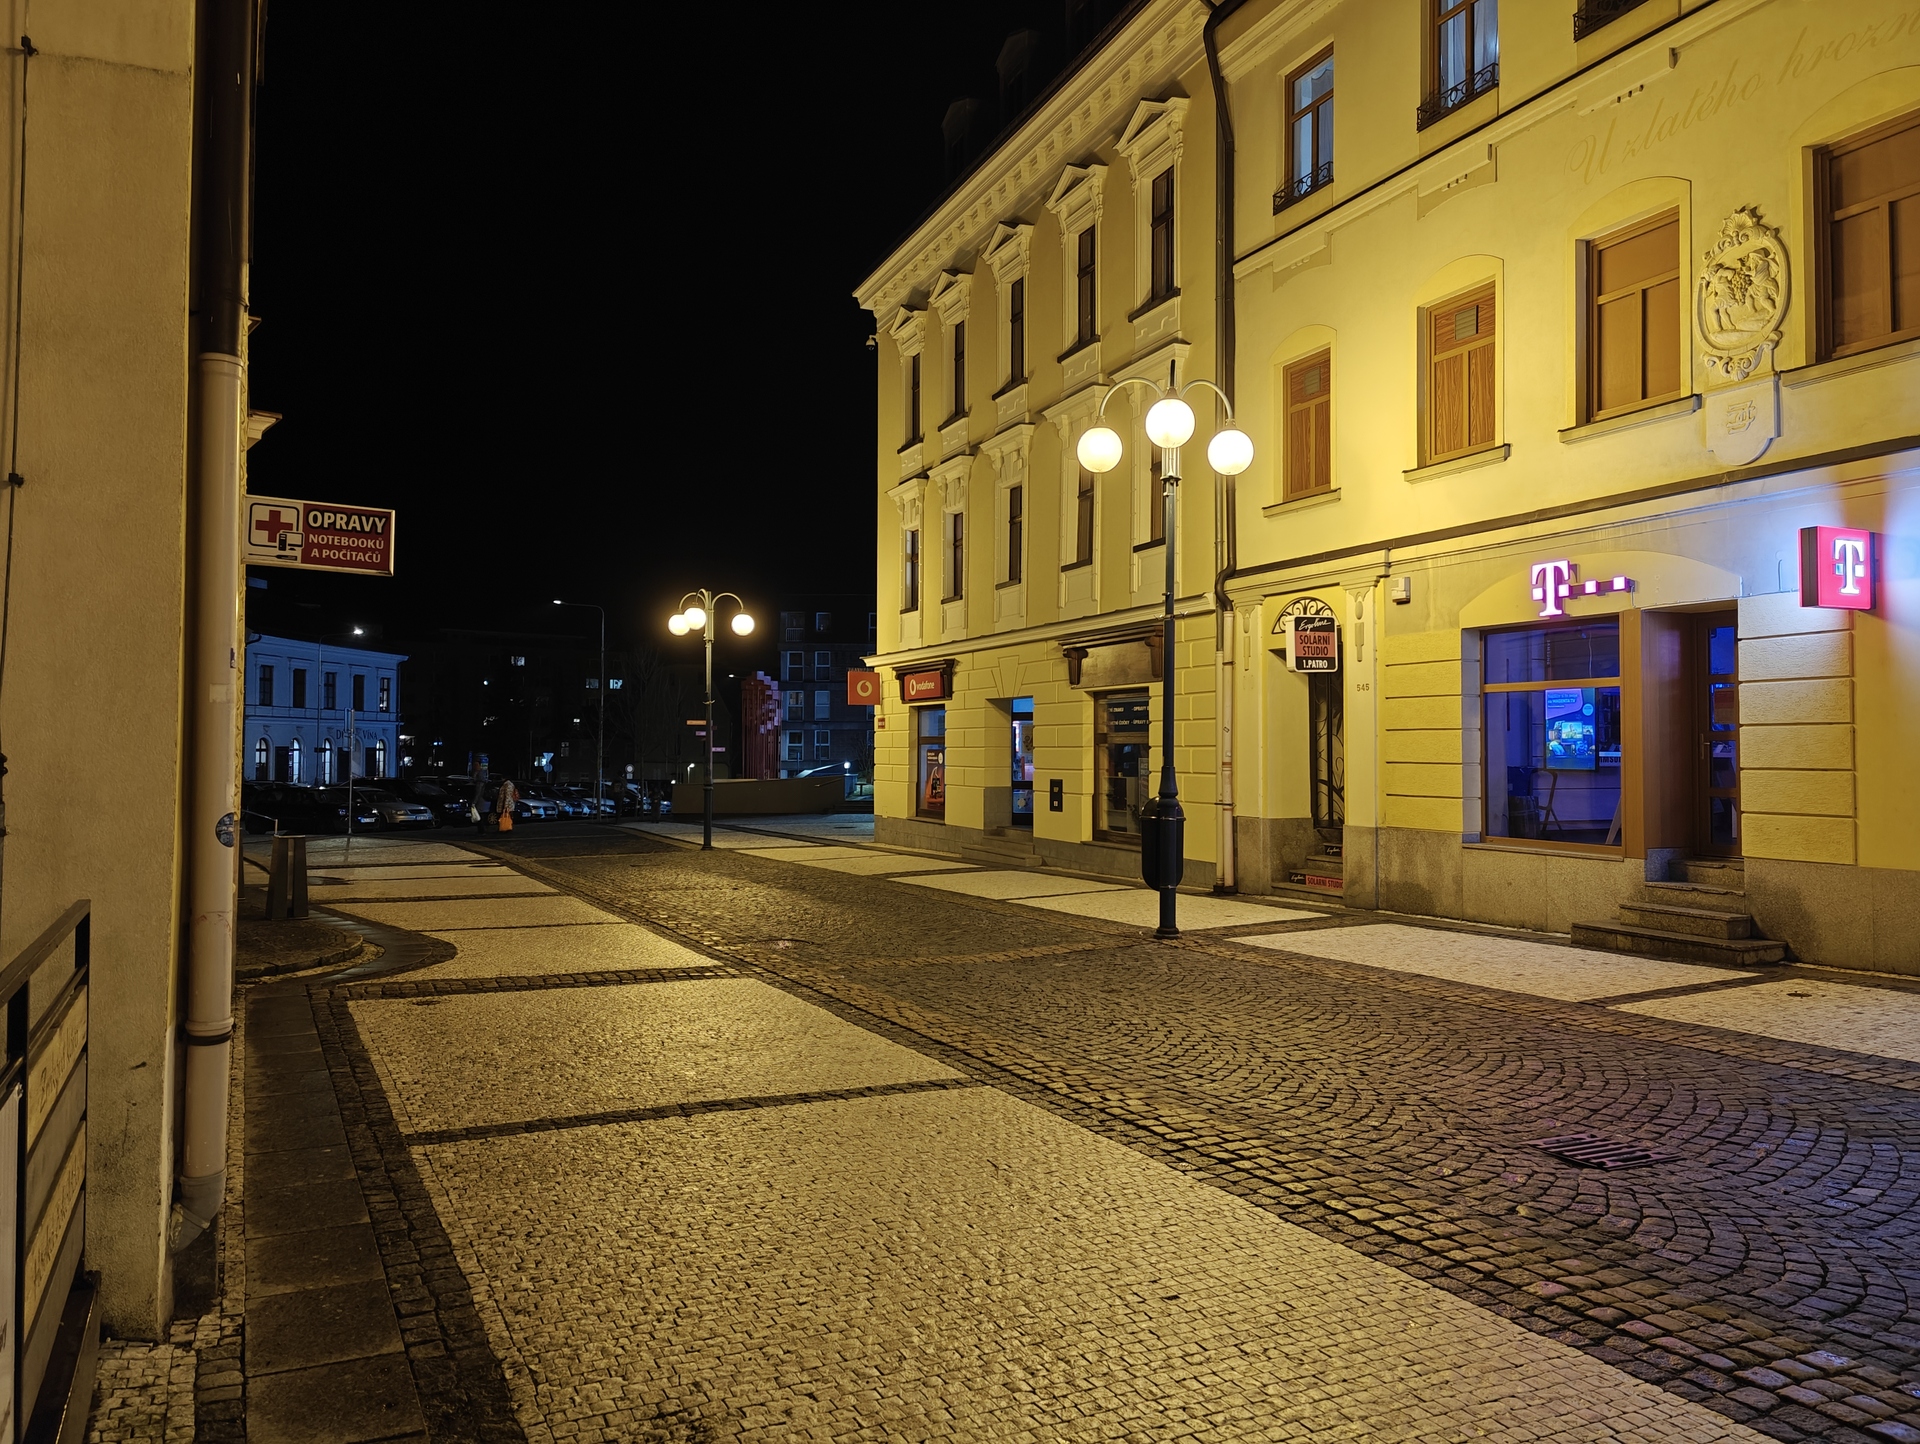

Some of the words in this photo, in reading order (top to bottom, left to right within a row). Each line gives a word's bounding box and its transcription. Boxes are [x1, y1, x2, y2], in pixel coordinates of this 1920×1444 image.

[1563, 116, 1617, 185] U
[1620, 57, 1765, 163] zlatého
[308, 510, 386, 533] OPRAVY
[308, 533, 384, 549] NOTEBOOKŮ
[310, 548, 319, 558] A
[322, 548, 381, 563] POČÍTAČŮ
[1299, 633, 1330, 645] SOLÁRNÍ
[1302, 645, 1328, 656] STUDIO
[1302, 659, 1328, 669] 1.PATRO
[916, 680, 935, 691] vodafone
